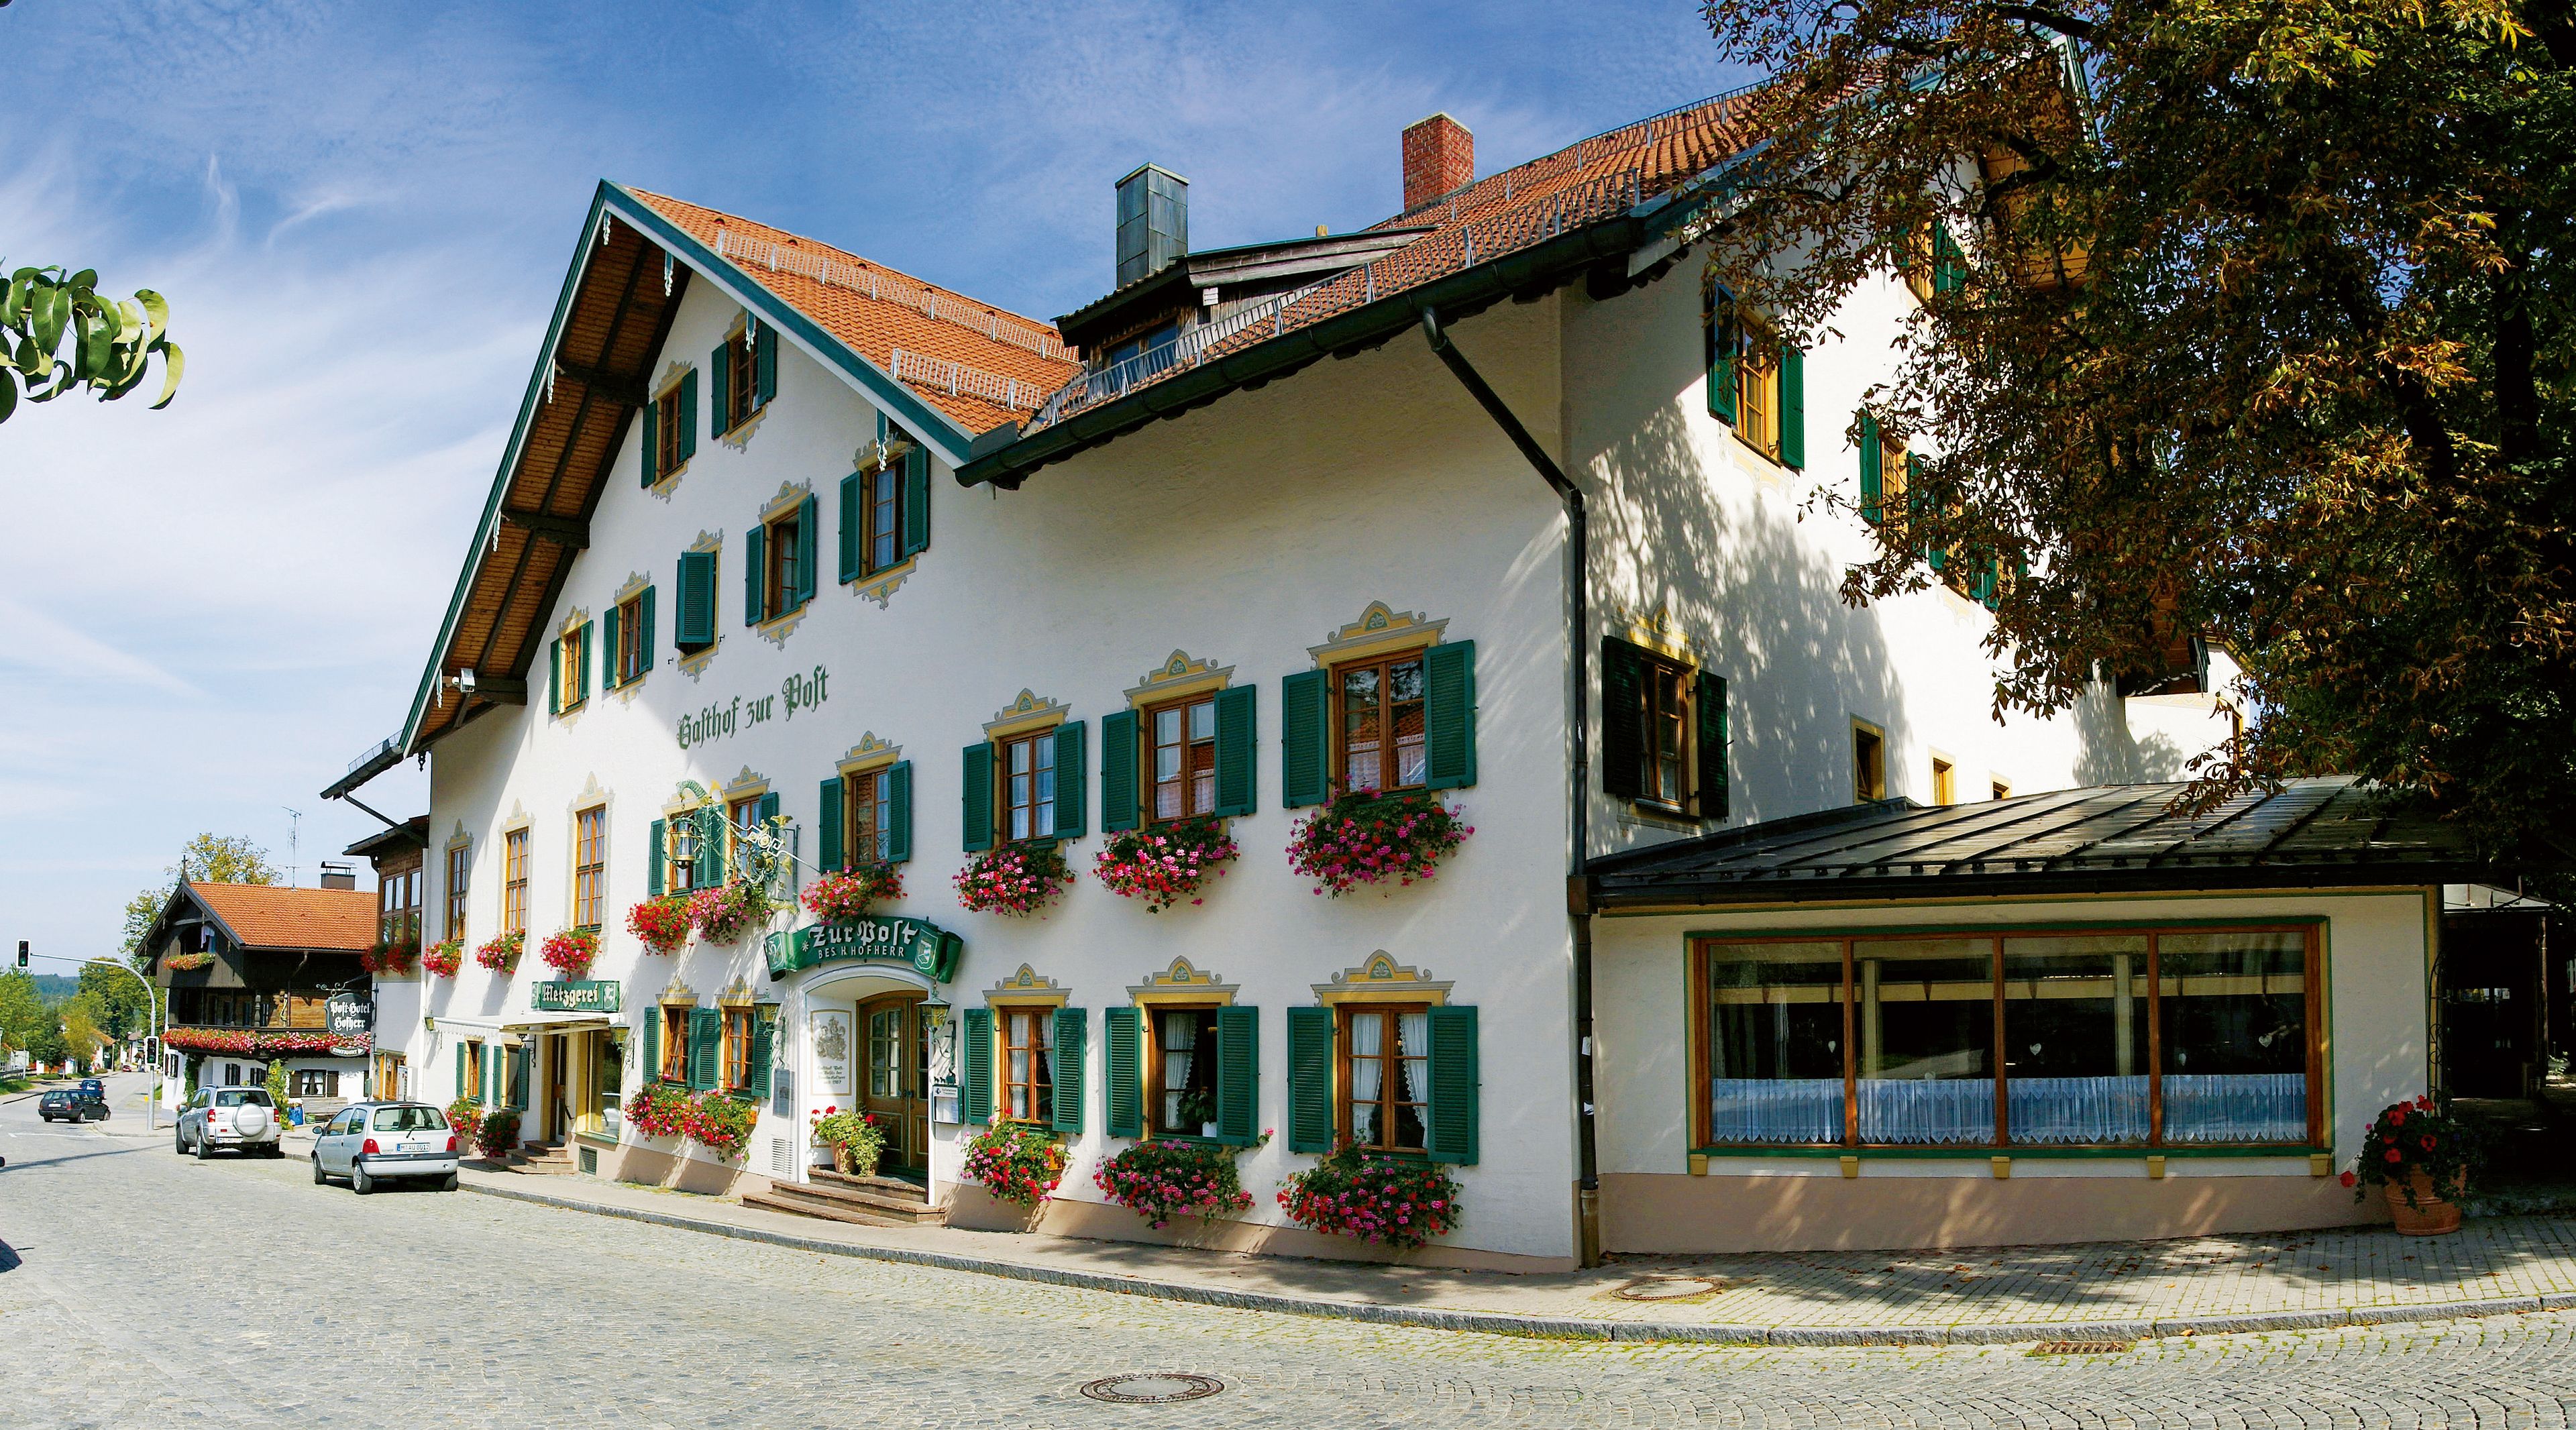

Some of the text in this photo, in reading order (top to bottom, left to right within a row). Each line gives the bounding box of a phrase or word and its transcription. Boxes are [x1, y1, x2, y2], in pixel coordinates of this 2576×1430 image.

[676, 663, 829, 750] Gasthof zur Post
[808, 920, 918, 948] Zur Post
[851, 945, 904, 957] HOFHERR
[542, 983, 598, 1008] Metzgerei
[334, 1016, 366, 1032] Hofherr
